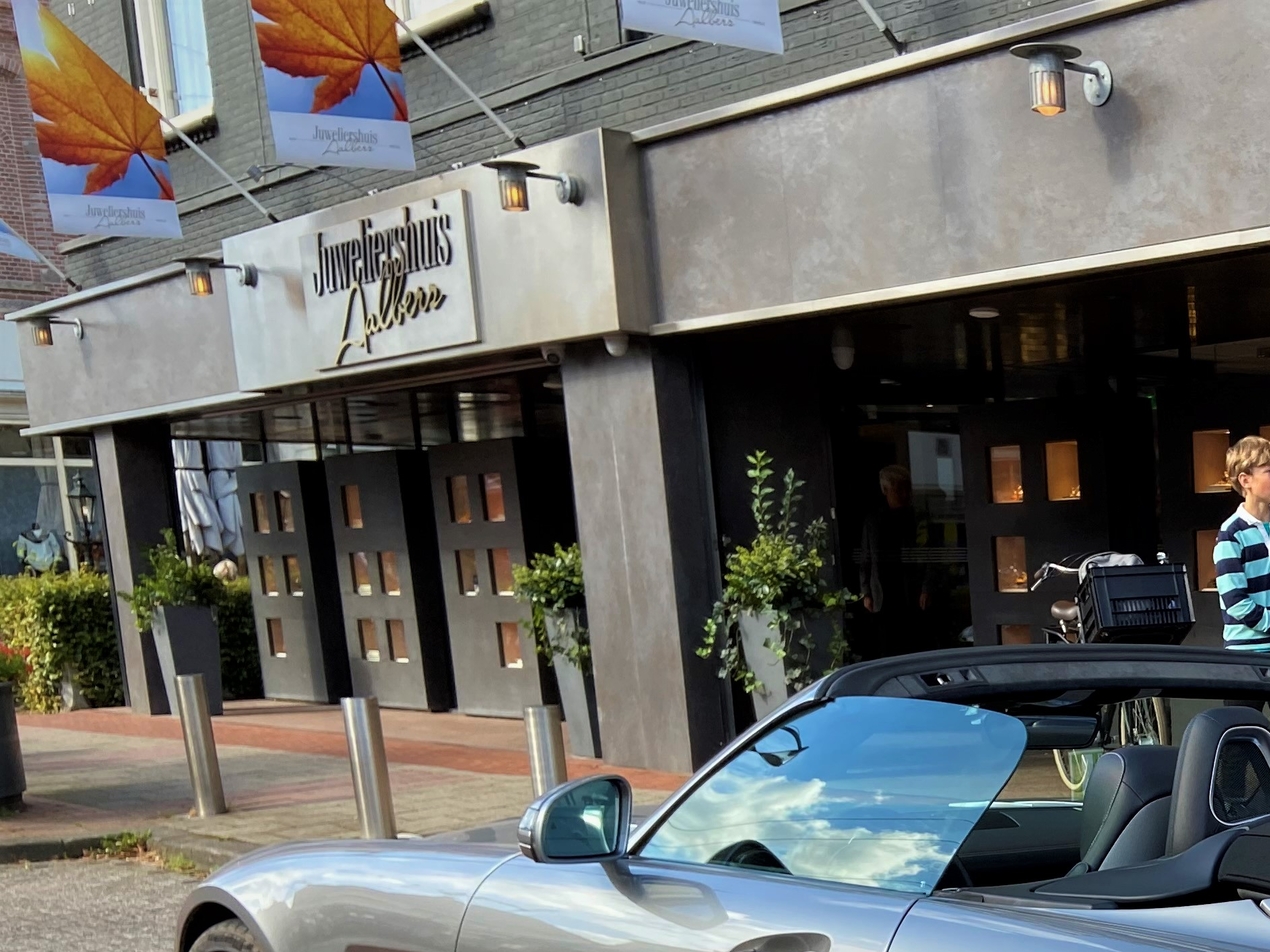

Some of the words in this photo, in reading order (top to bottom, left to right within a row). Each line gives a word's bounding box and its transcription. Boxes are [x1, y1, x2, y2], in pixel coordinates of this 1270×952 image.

[313, 124, 378, 144] Juweliershuis
[313, 198, 453, 297] Juweliershuis
[335, 257, 448, 366] Aalbers
